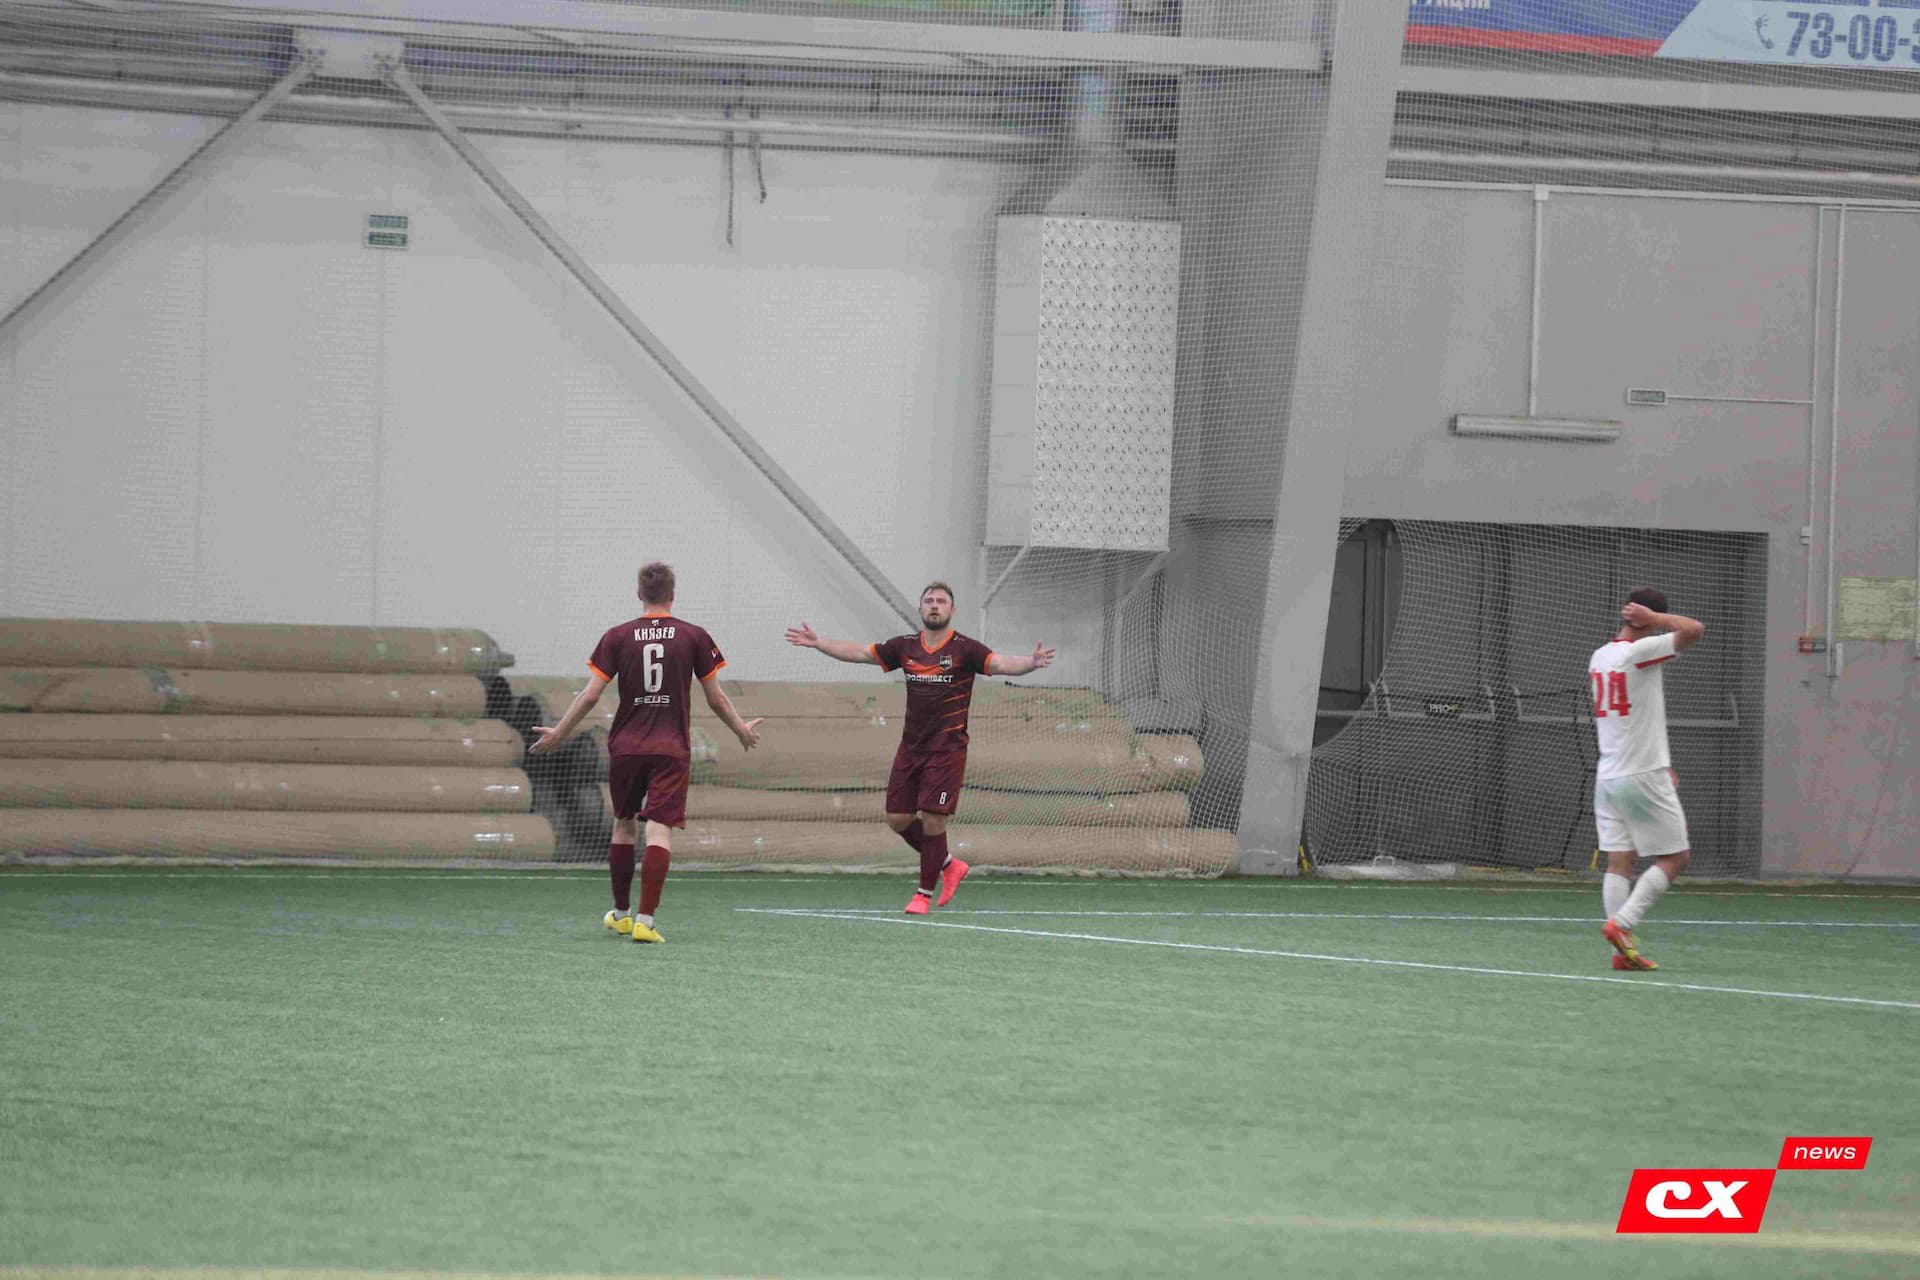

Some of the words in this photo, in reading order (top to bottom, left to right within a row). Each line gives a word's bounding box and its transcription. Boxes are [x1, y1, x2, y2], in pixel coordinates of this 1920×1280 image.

[634, 627, 676, 641] КНЯЗЕВ
[643, 643, 664, 693] 6
[1589, 669, 1632, 717] 24
[939, 791, 947, 805] 8
